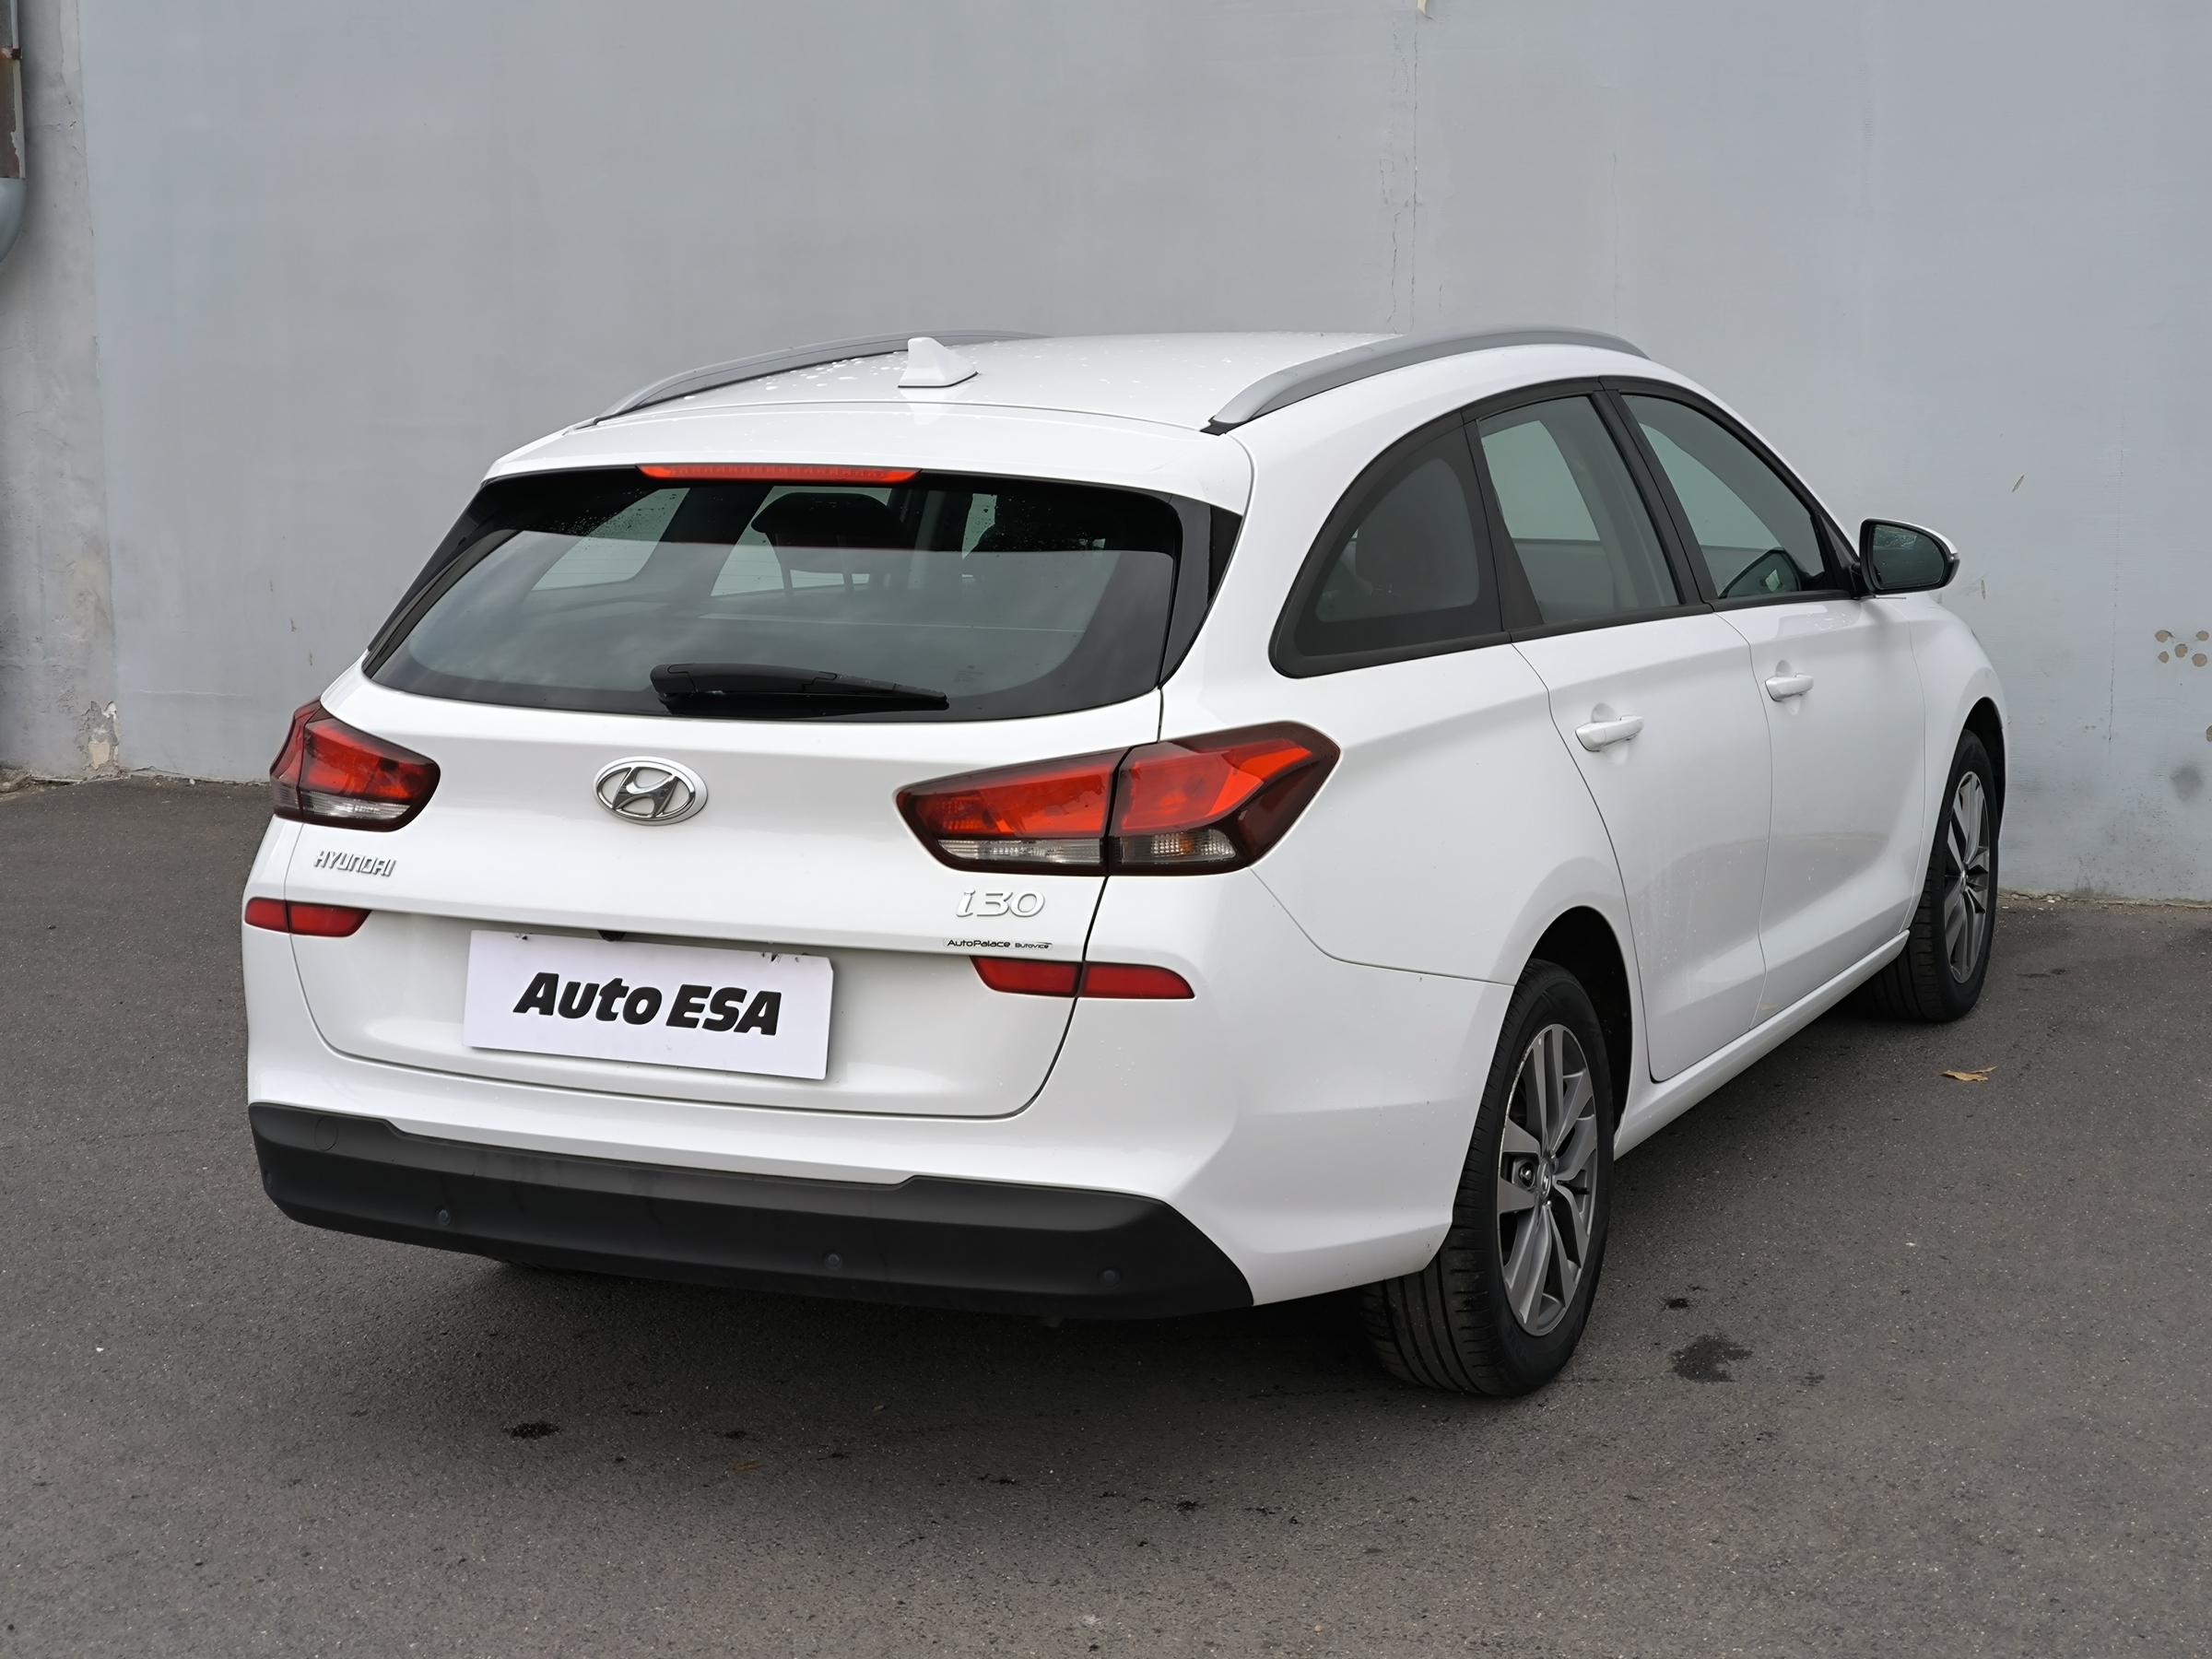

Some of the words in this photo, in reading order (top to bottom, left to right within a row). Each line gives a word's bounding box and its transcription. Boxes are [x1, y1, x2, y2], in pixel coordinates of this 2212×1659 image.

[314, 850, 396, 877] HYUNDAI
[956, 888, 1045, 917] i30
[947, 939, 1011, 948] AutoPalace
[512, 971, 663, 1025] Auto
[665, 983, 782, 1036] ESA
